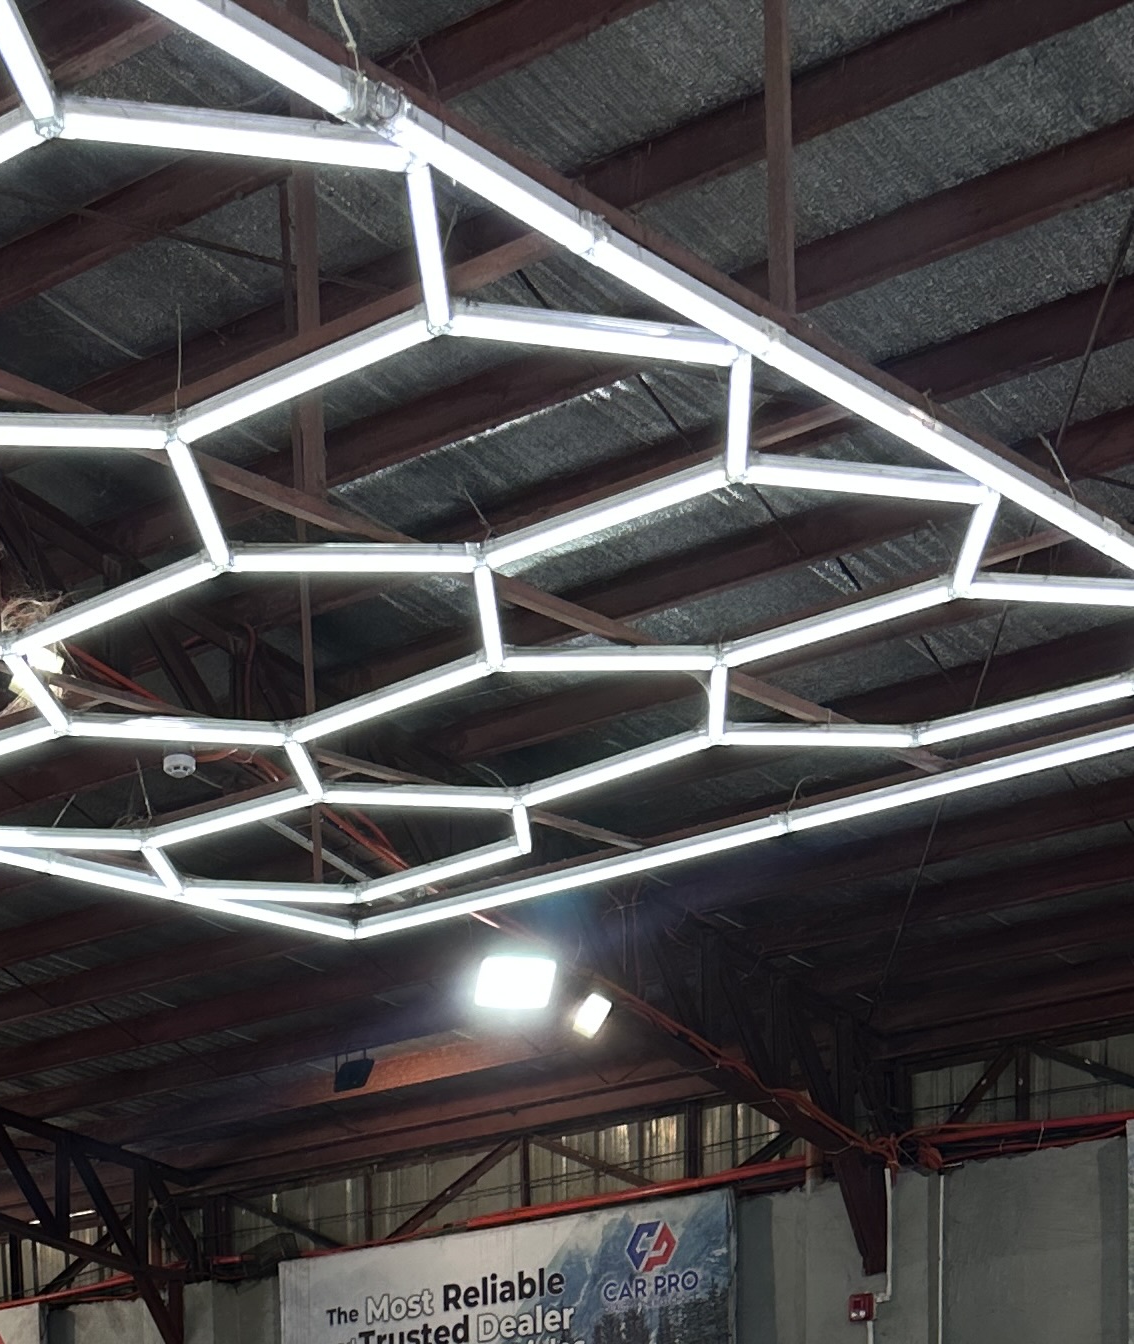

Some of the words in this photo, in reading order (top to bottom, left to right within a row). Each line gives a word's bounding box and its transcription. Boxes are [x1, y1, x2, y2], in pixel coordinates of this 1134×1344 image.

[327, 1306, 359, 1327] The
[365, 1289, 434, 1324] Most
[443, 1268, 565, 1312] Reliable
[603, 1276, 646, 1302] CAR
[654, 1270, 699, 1294] PRO
[476, 1305, 575, 1344] Dealer
